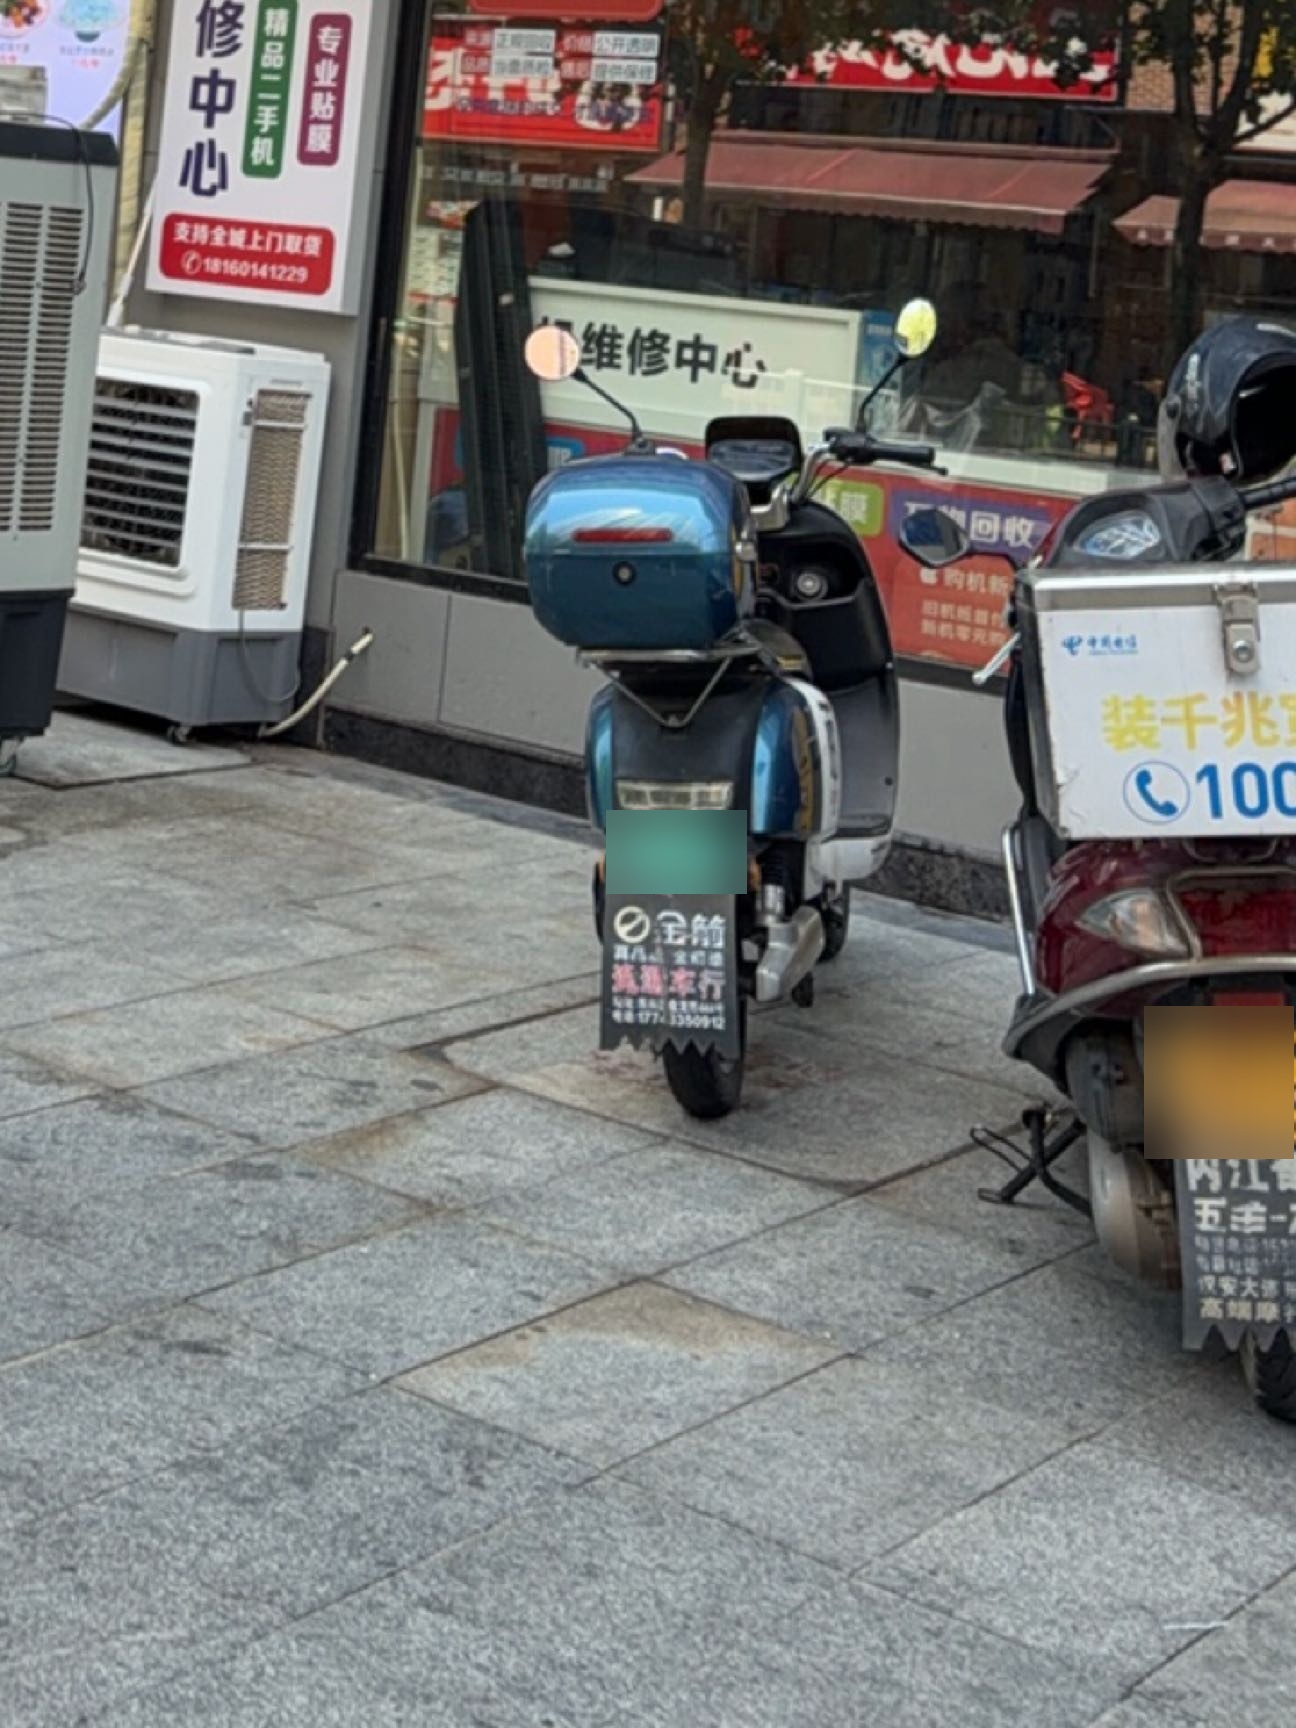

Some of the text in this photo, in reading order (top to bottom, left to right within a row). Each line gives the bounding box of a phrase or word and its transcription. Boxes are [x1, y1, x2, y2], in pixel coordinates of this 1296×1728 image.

[249, 7, 289, 166] 精品二手机
[304, 25, 344, 153] 专业贴膜
[542, 316, 767, 389] 维修中心
